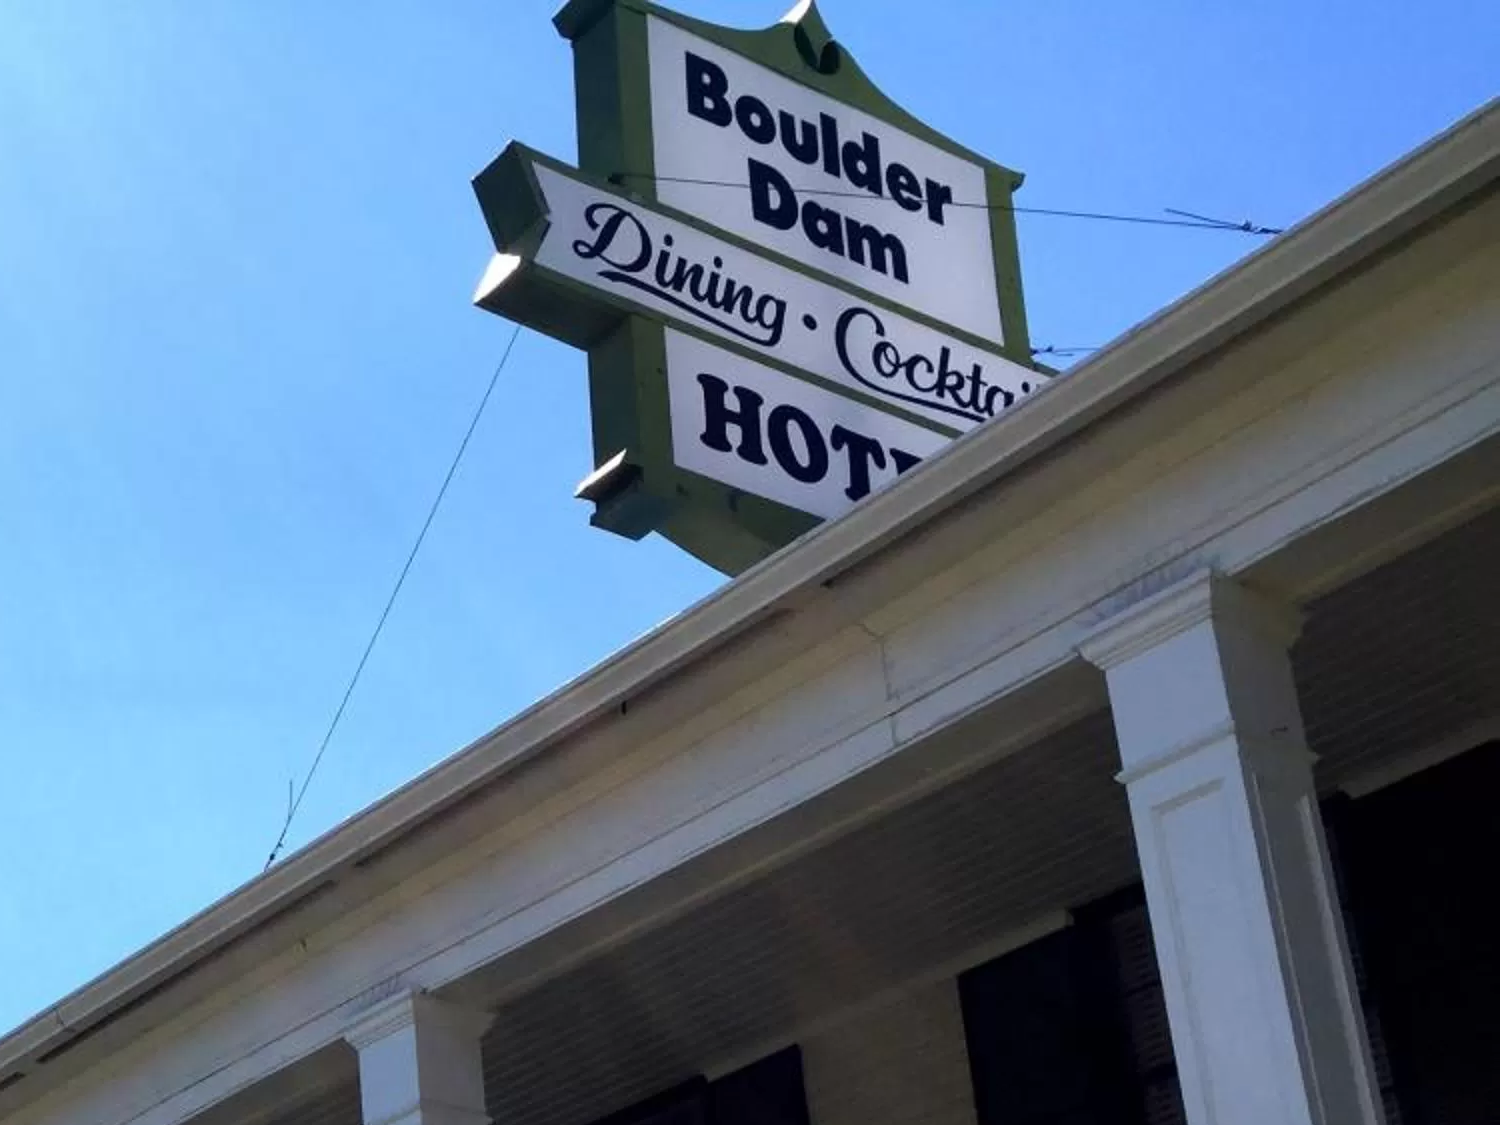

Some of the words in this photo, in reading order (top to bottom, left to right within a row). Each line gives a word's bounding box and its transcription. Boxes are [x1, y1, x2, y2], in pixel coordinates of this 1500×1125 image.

[684, 51, 952, 225] Boulder
[748, 157, 908, 284] Dam
[572, 203, 786, 347] Dining
[835, 307, 1030, 422] Cockta
[697, 373, 923, 501] HOT
